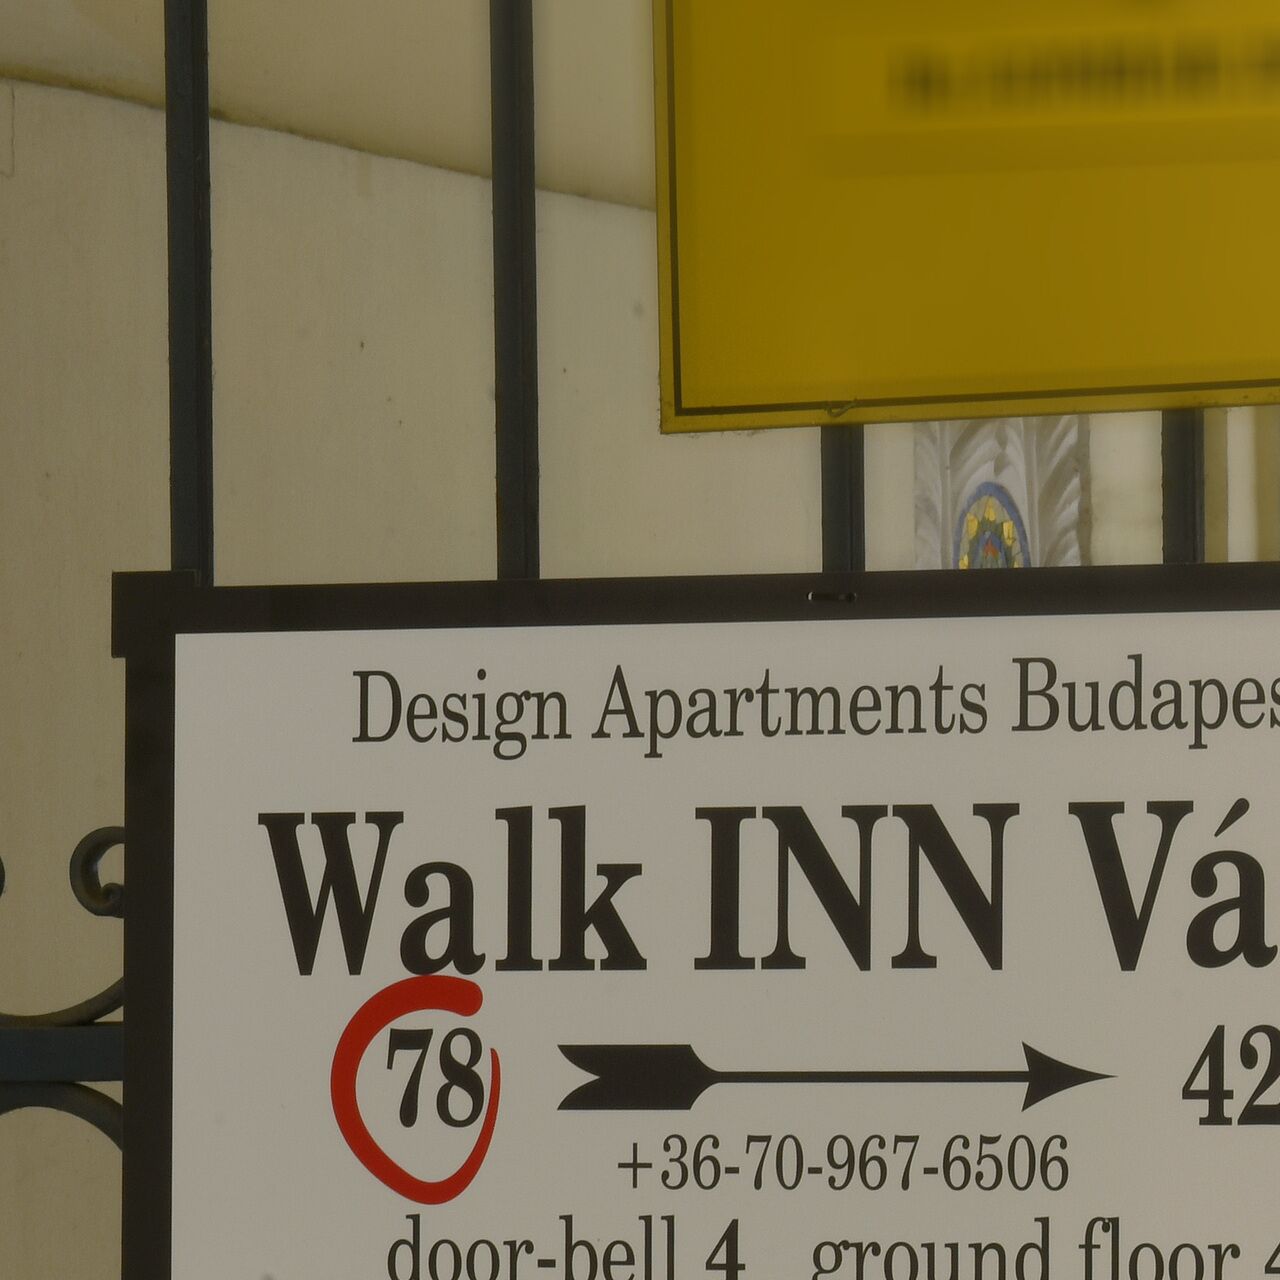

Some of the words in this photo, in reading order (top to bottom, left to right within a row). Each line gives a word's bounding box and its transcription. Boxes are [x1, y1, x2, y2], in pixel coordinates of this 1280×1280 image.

[353, 668, 571, 760] Design
[592, 664, 987, 758] Apartments
[258, 805, 647, 975] Walk
[694, 803, 1019, 971] INN
[386, 1027, 485, 1128] 78
[617, 1133, 1069, 1191] +36-70-967-6506
